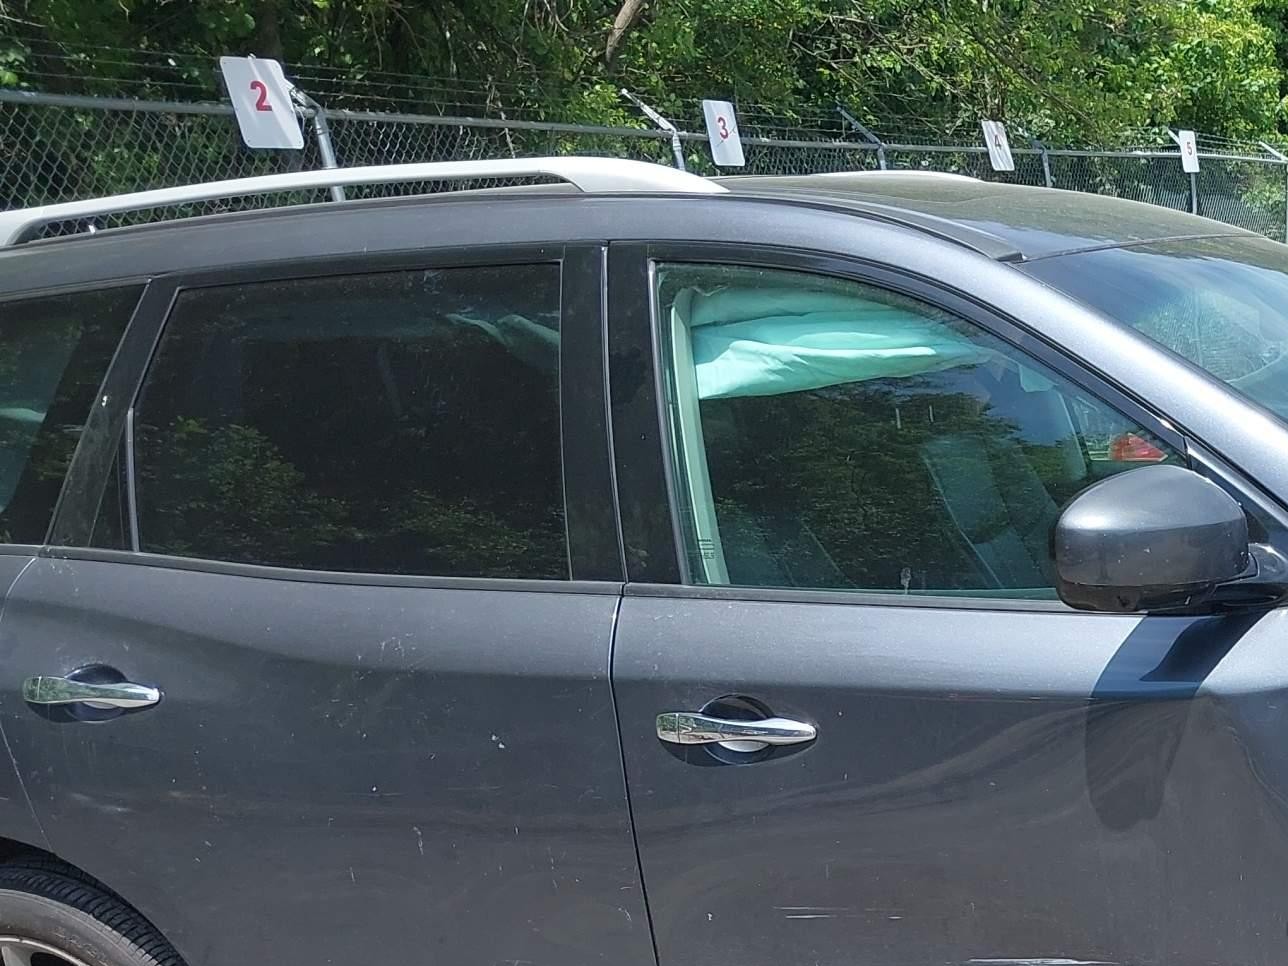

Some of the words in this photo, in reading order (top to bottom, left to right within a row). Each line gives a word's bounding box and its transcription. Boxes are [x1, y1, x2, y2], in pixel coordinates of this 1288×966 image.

[250, 80, 273, 111] 2
[717, 116, 729, 139] 3
[1186, 141, 1193, 156] 5
